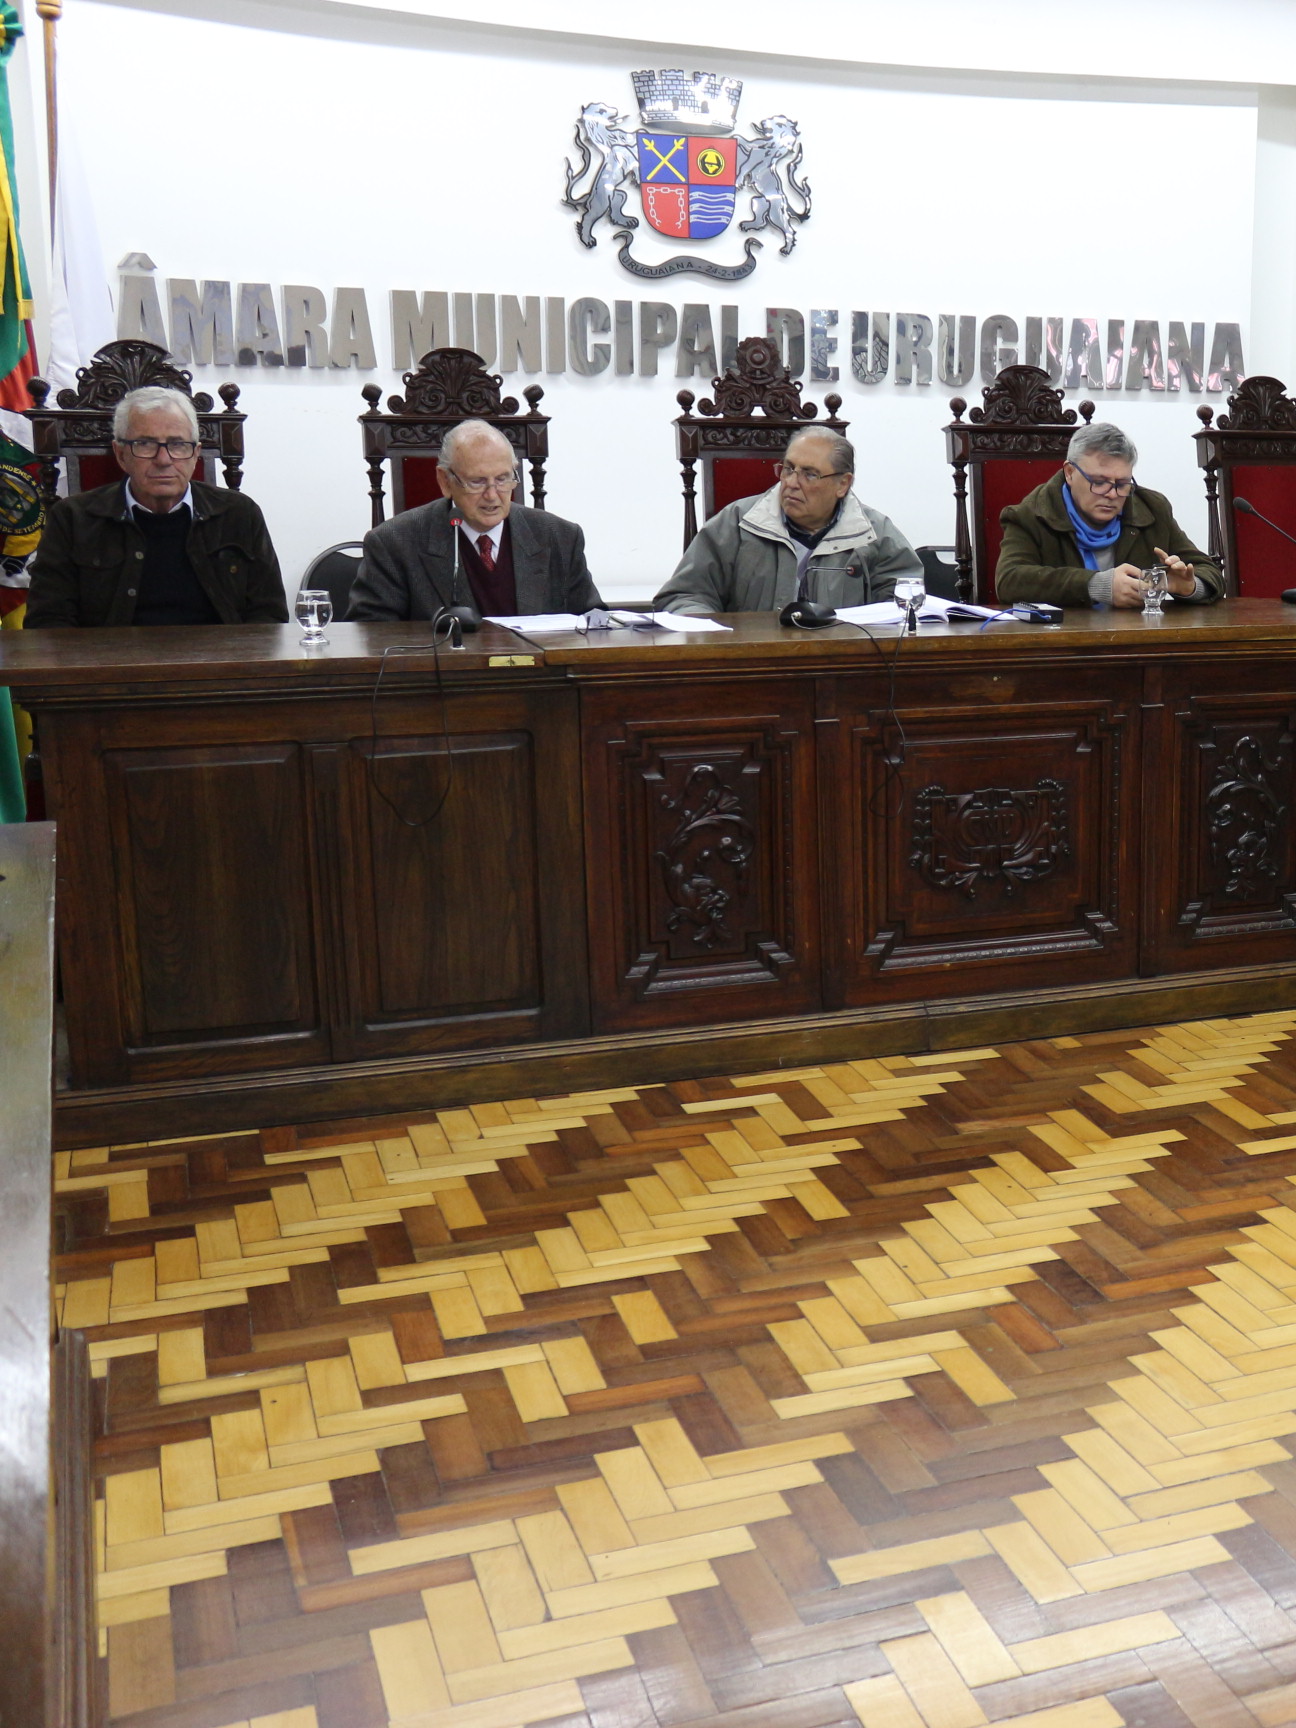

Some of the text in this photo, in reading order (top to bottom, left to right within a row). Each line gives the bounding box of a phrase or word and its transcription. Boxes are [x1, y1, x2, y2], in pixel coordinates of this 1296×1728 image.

[622, 256, 694, 275] URUGUAIANA
[117, 252, 1247, 393] ÂMARA MUNICIPAL DE URUGUAIANA
